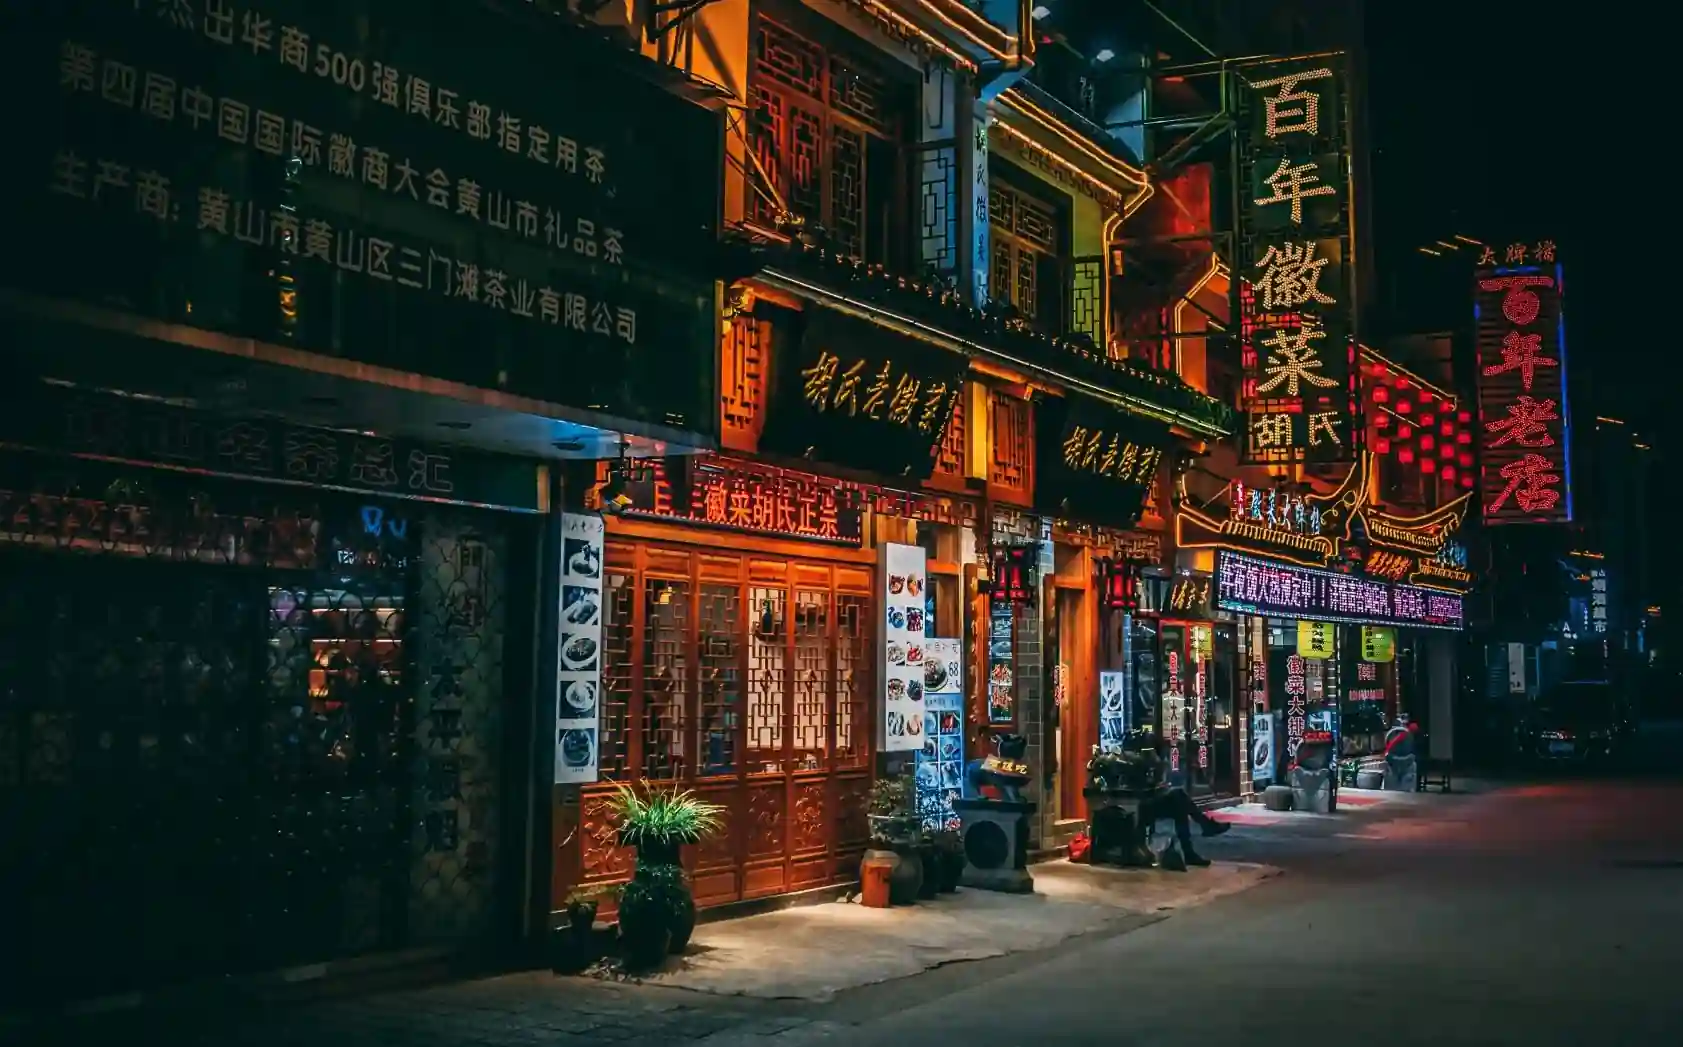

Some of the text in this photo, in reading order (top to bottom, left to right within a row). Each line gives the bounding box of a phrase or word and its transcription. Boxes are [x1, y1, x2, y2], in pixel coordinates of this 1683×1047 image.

[59, 40, 625, 265] 第四届中国国际徽商大会黄山市礼品茶
[131, 0, 606, 184] 杰出华商500强俱乐部指定用茶
[1250, 67, 1340, 397] 百年徽菜
[1254, 409, 1341, 447] 胡氏
[1479, 276, 1559, 512] 百年老店
